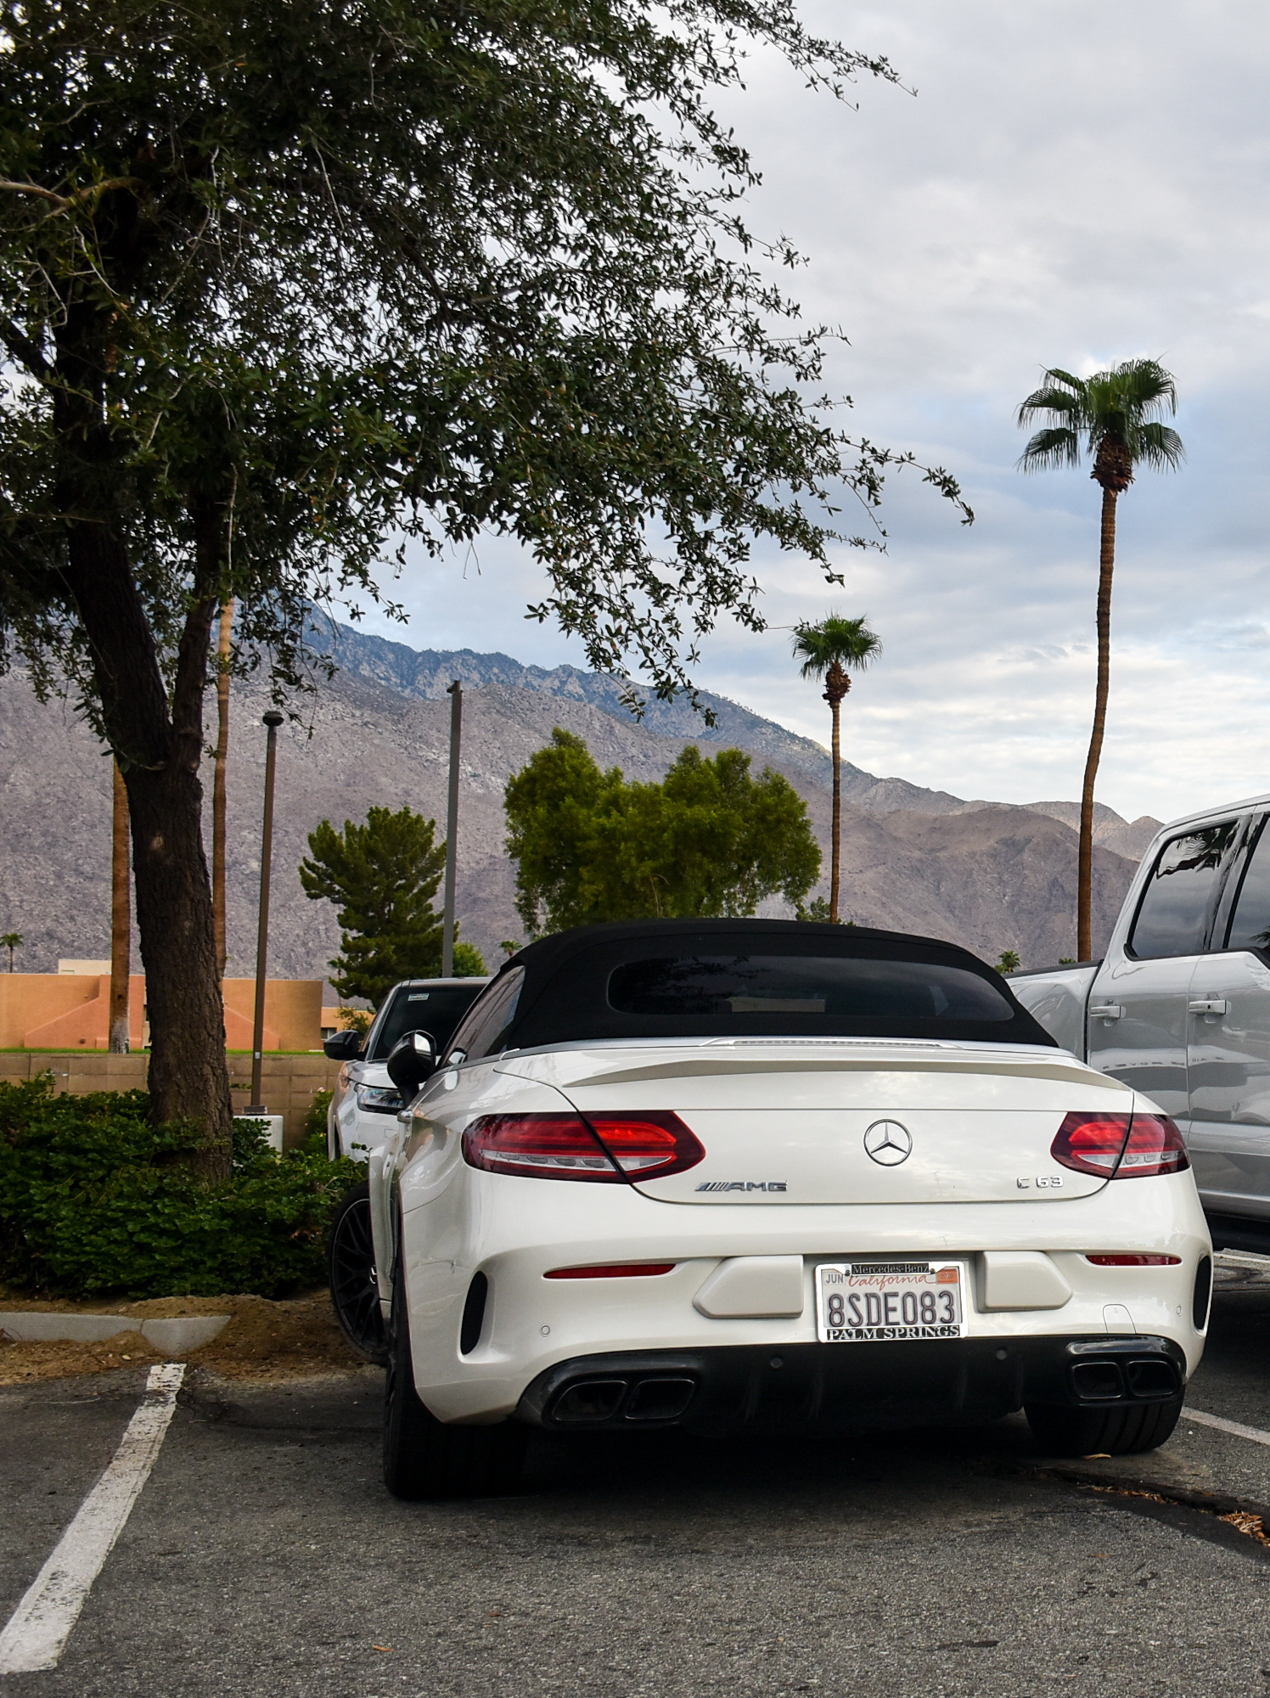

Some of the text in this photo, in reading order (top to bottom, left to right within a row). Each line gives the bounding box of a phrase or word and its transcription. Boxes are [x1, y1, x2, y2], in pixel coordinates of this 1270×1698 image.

[724, 1182, 787, 1192] AMG
[1016, 1175, 1063, 1188] C 63
[853, 1263, 929, 1275] Mercedes-Benz
[826, 1274, 844, 1284] JUN
[848, 1275, 936, 1290] California
[828, 1290, 955, 1327] 8SDE083
[829, 1325, 960, 1340] PALM SPRINGS
